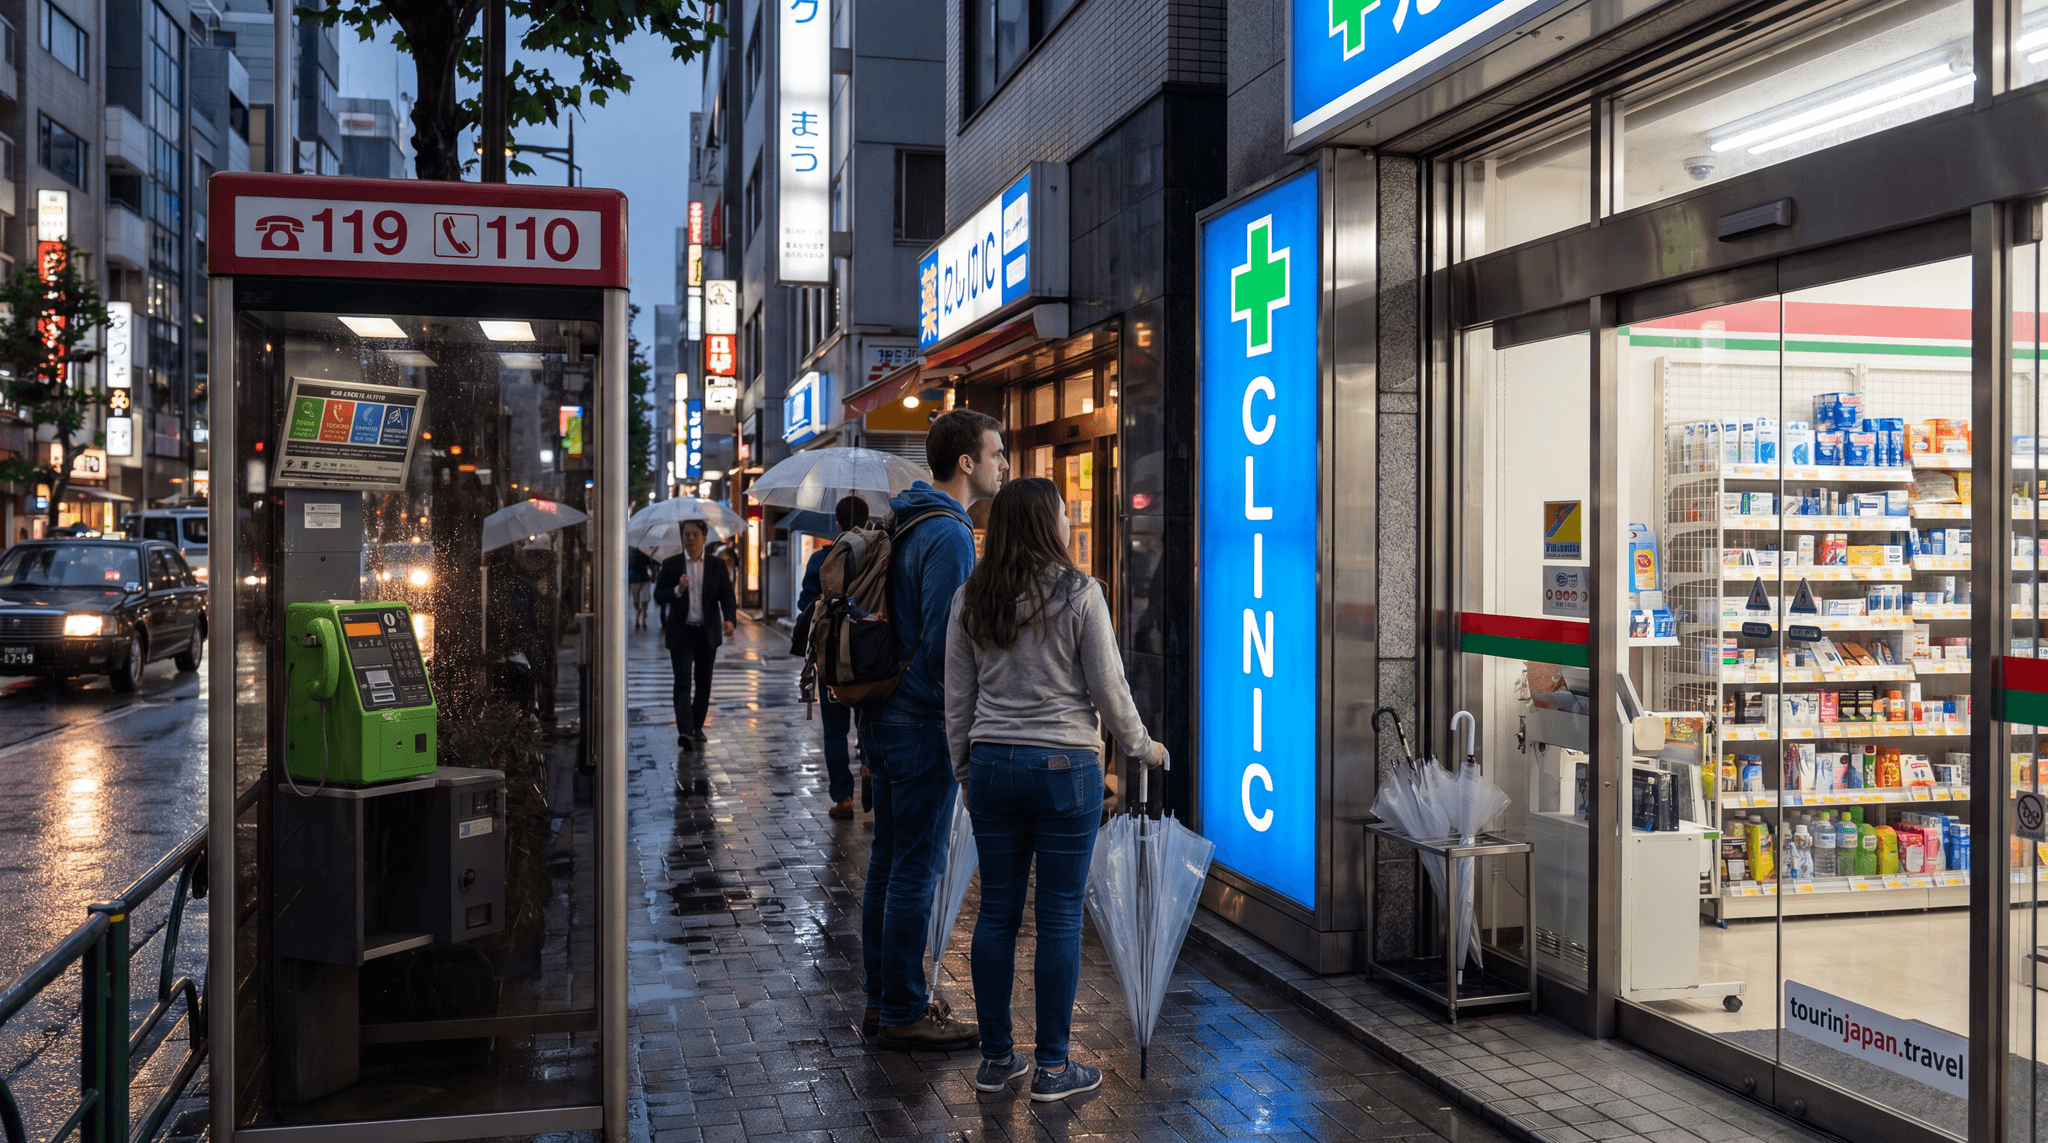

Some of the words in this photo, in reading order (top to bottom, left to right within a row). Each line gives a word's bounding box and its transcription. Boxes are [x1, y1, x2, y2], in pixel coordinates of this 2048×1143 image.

[312, 208, 408, 256] 119
[486, 215, 580, 262] 110
[1242, 376, 1277, 832] CLINIC
[1790, 996, 1964, 1080] tourinjapan.travel
